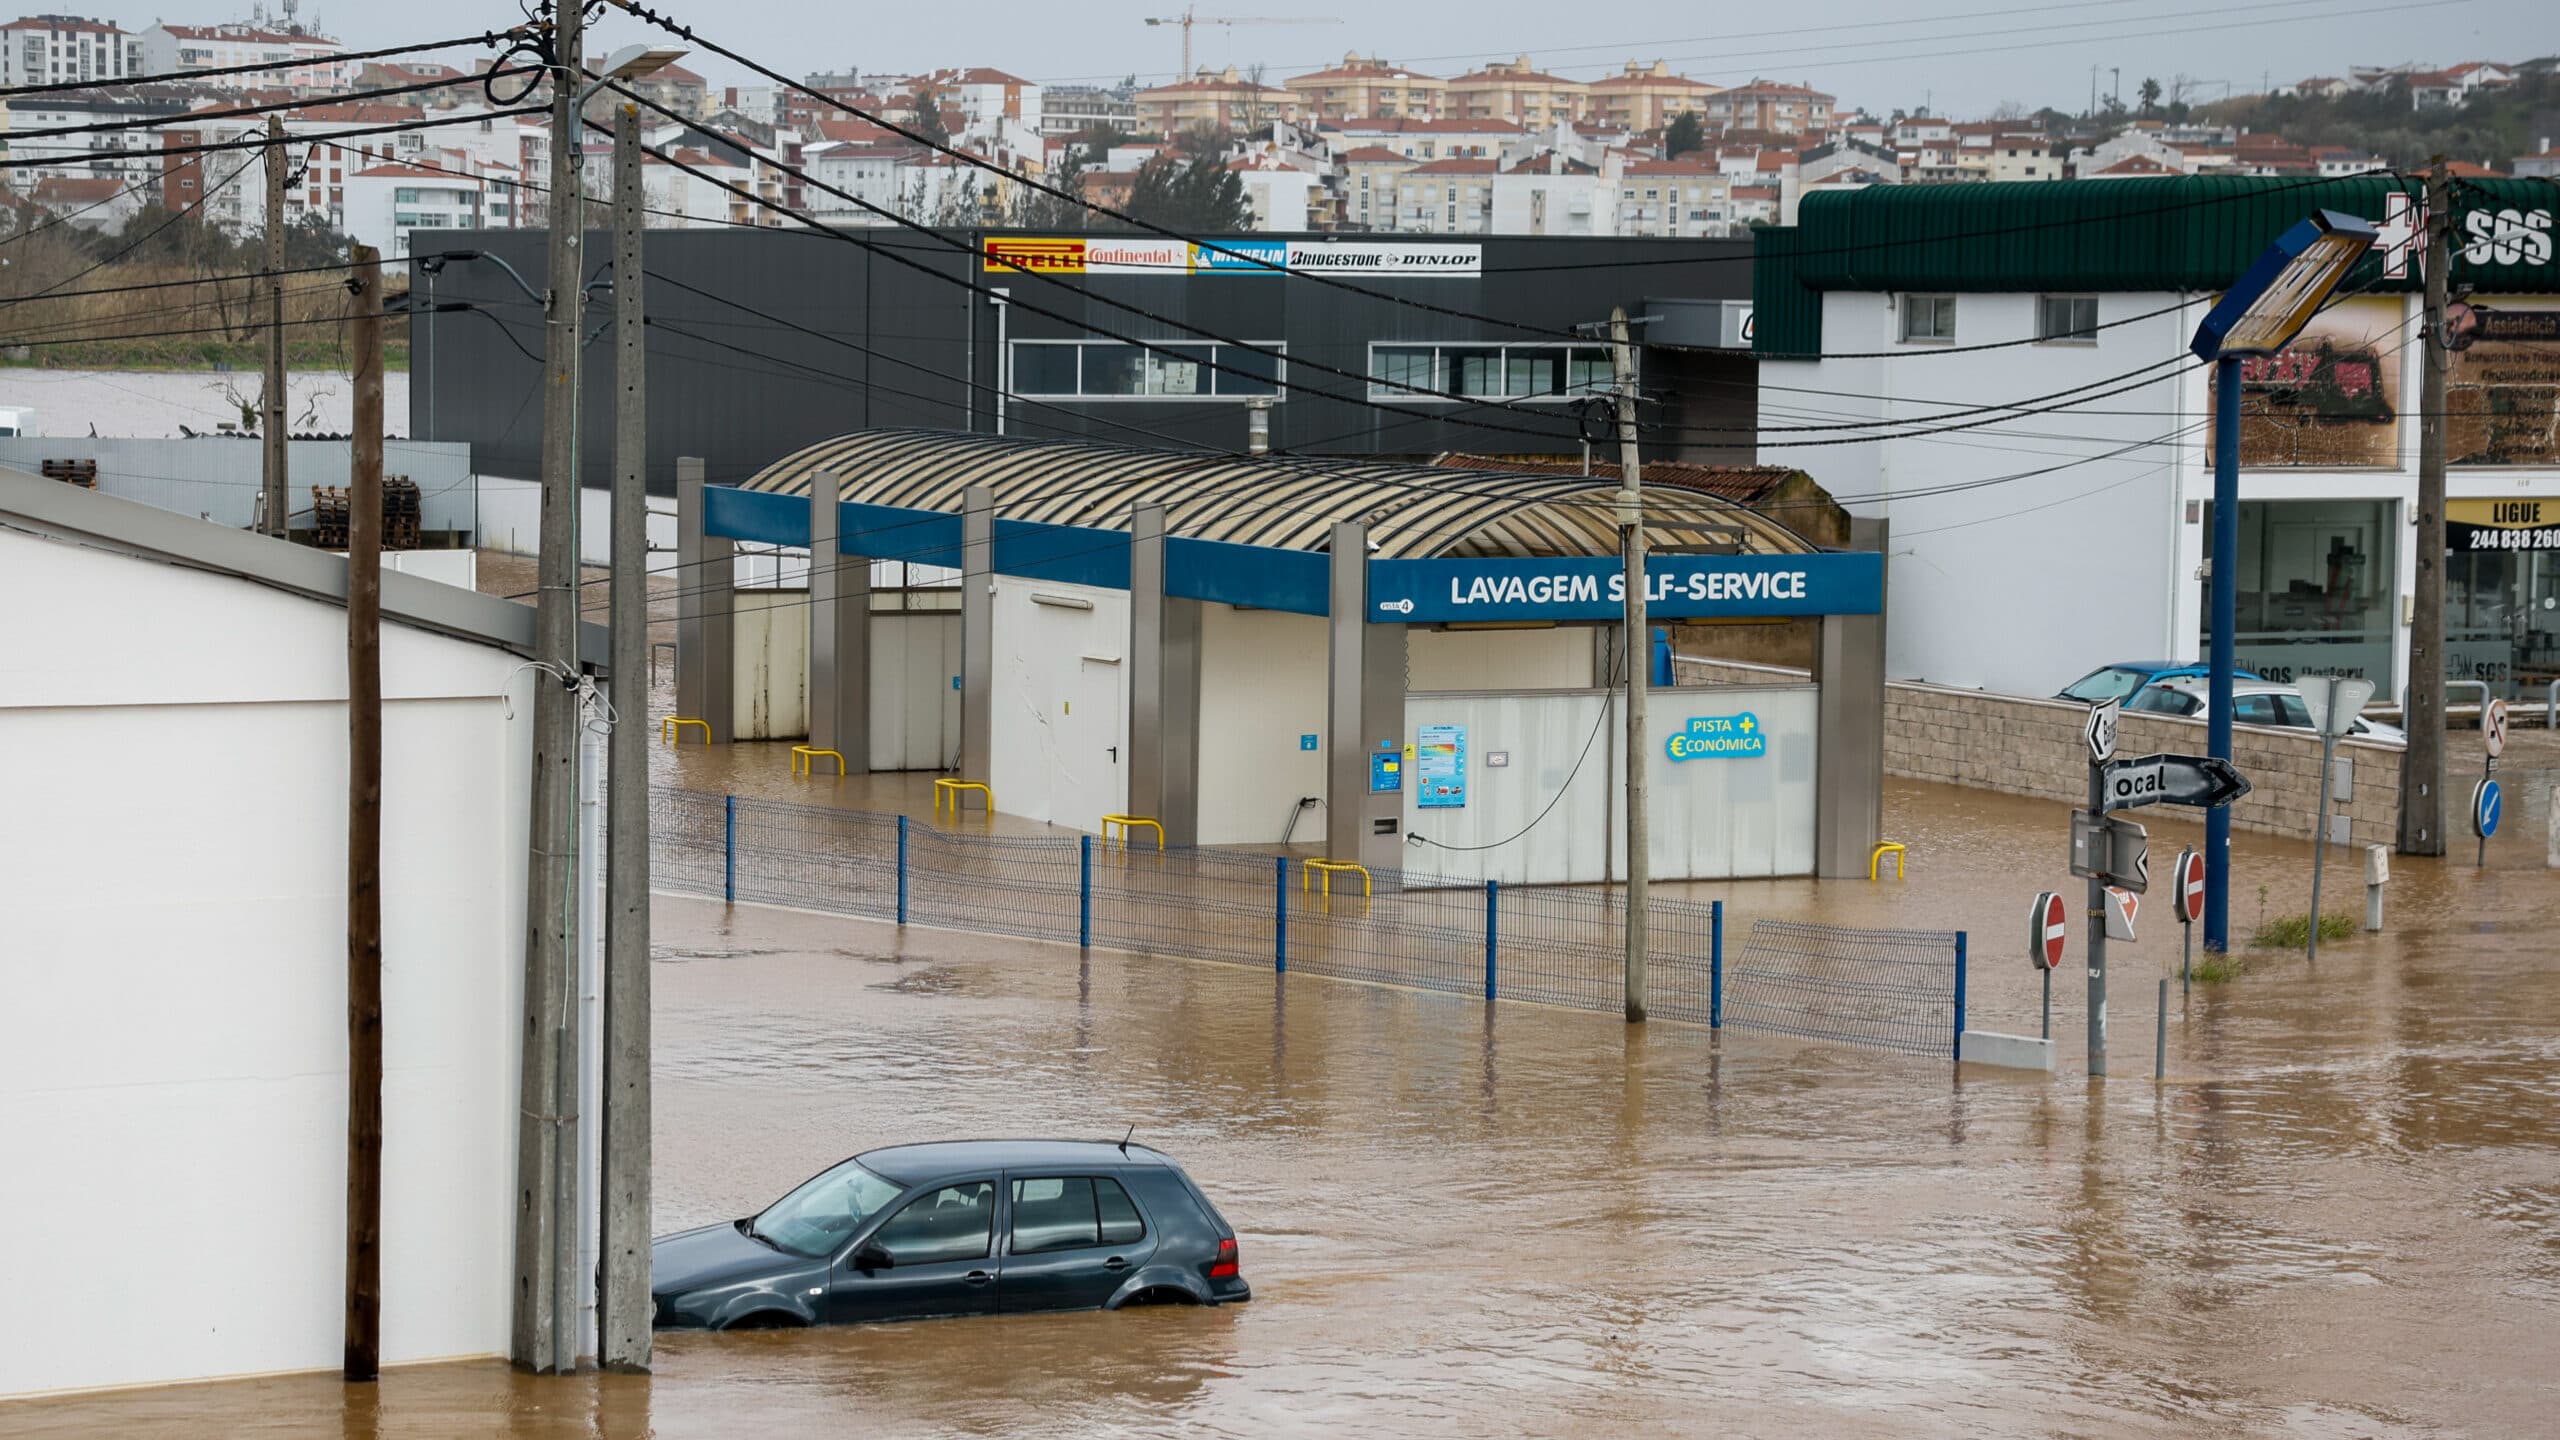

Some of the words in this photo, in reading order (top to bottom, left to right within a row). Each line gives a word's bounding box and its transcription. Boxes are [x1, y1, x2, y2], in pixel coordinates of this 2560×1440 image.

[2466, 208, 2553, 266] SOS
[1088, 247, 1172, 265] Continental
[1290, 251, 1383, 267] BRIDGESTONE
[1401, 255, 1477, 265] DUNLOP
[2494, 502, 2541, 523] LIGUE
[2470, 530, 2499, 549] 244
[2501, 530, 2531, 549] 838
[2533, 529, 2560, 549] 260
[1451, 575, 1599, 604] LAVAGEM
[1608, 572, 1807, 602] SLF-SERVICE
[1693, 720, 1732, 733] PISTA
